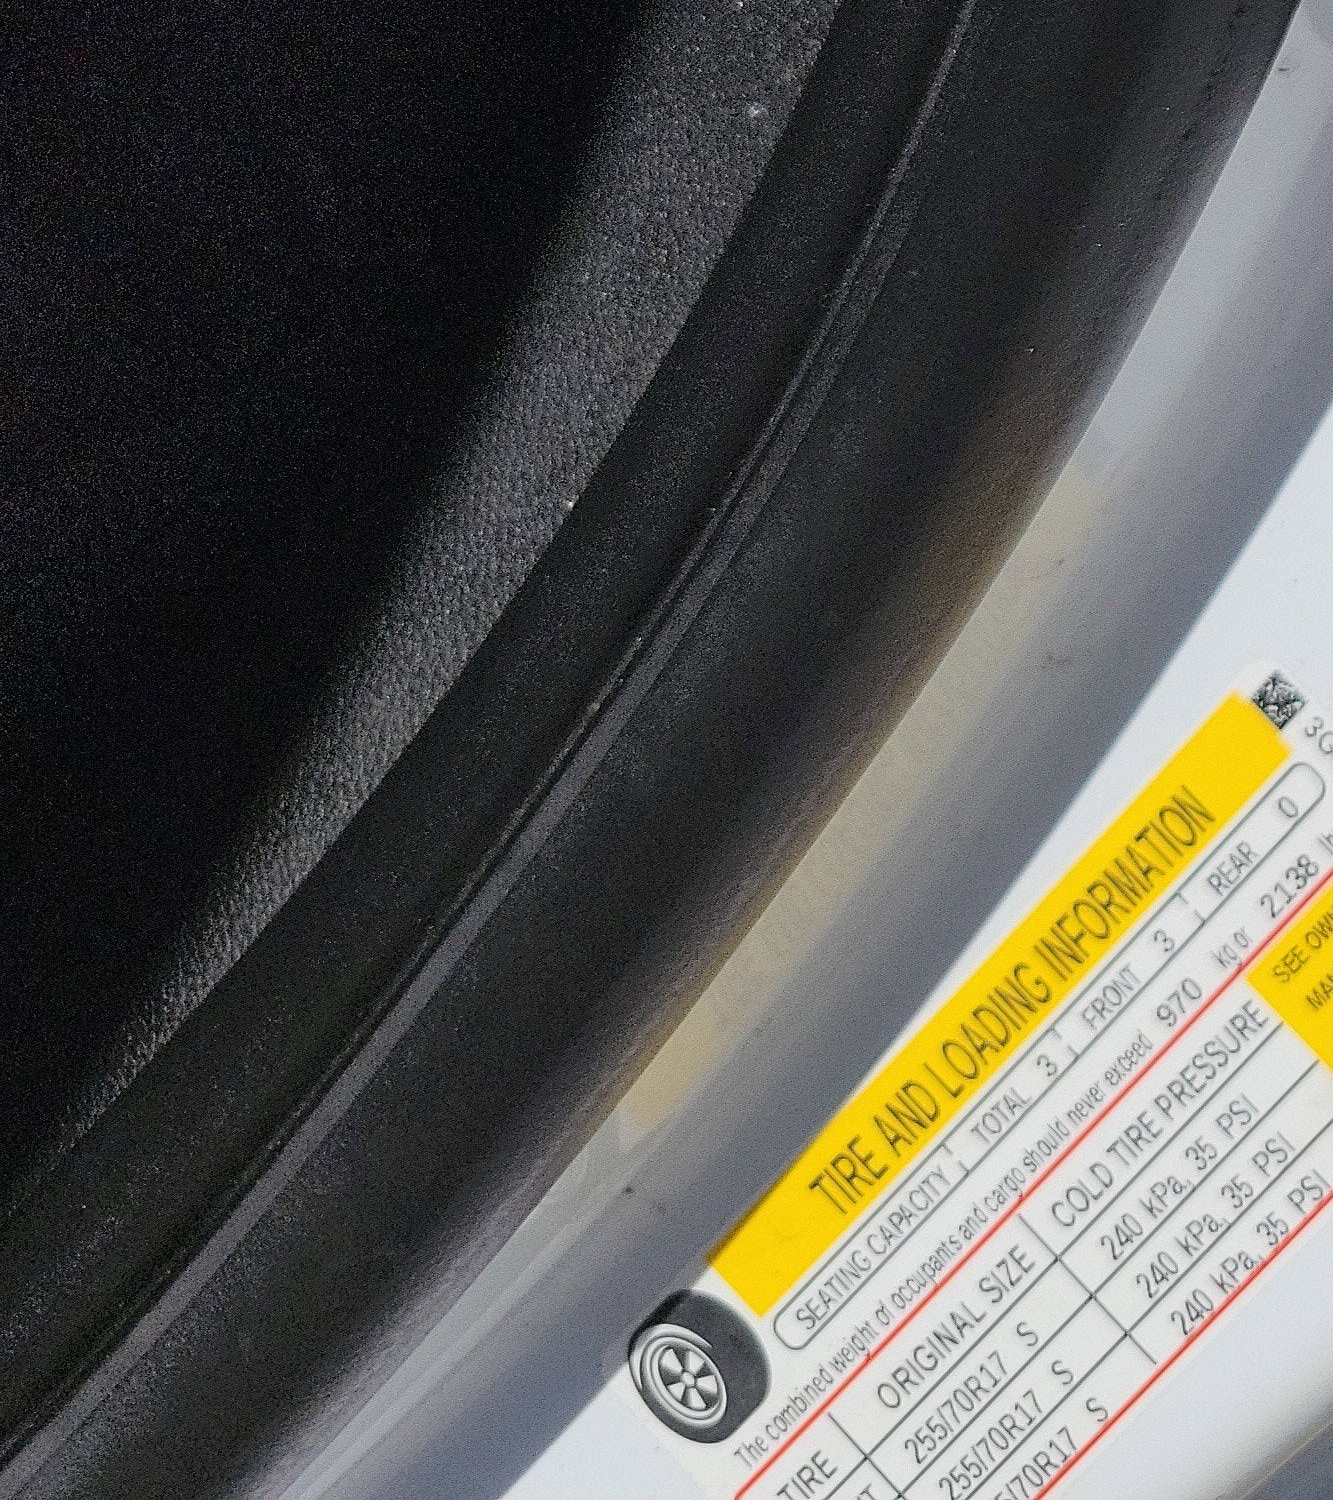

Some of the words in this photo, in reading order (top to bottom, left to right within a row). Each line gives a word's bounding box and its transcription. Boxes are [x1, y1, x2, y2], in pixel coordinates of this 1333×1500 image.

[1206, 841, 1253, 897] REAR
[1277, 796, 1299, 819] 0
[807, 1136, 889, 1214] TIRE
[873, 1081, 941, 1158] AND
[924, 963, 1053, 1100] LOADING
[1033, 785, 1215, 982] INFORMATION
[1080, 965, 1139, 1030] FRONT
[1153, 929, 1175, 953] 3
[1273, 945, 1309, 983] SEE
[732, 1436, 769, 1468] The
[760, 1363, 837, 1445] combined
[825, 1315, 887, 1381] weight
[870, 1299, 898, 1329] of
[887, 1230, 967, 1316] occupants
[953, 1203, 991, 1243] and
[980, 1163, 1032, 1218] cargo
[1022, 1119, 1070, 1174] should
[1065, 1080, 1105, 1126] never
[1103, 1033, 1154, 1087] exceed
[1156, 978, 1203, 1028] 970
[1211, 941, 1244, 975] kg
[1229, 924, 1255, 951] or
[1259, 854, 1319, 919] 2138
[795, 1250, 871, 1331] SEATING
[866, 1166, 950, 1256] CAPACITY
[969, 1087, 1031, 1144] TOTAL
[1036, 1054, 1058, 1078] 3
[1051, 1162, 1114, 1228] COLD
[1105, 1111, 1163, 1166] TIRE
[1153, 1000, 1268, 1120] PRESSURE
[1100, 1213, 1144, 1261] 240
[1137, 1163, 1194, 1223] kPa,
[1184, 1137, 1218, 1172] 35
[1215, 1094, 1259, 1139] PSI
[1135, 1252, 1179, 1300] 240
[1173, 1200, 1230, 1261] kPa,
[1220, 1175, 1254, 1210] 35
[1251, 1133, 1295, 1178] PSI
[1170, 1289, 1214, 1336] 240
[1209, 1238, 1265, 1297] kPa,
[1255, 1212, 1289, 1247] 35
[1286, 1169, 1330, 1214] PSI
[876, 1303, 987, 1410] ORIGINAL
[978, 1245, 1036, 1304] SIZE
[903, 1350, 1007, 1466] 255/70R17
[1015, 1321, 1039, 1348] S
[775, 1450, 838, 1498] TIRE
[938, 1389, 1043, 1499] 255/70R17
[1051, 1360, 1074, 1386] S
[995, 1426, 1077, 1498] /70R17
[1085, 1397, 1109, 1423] S
